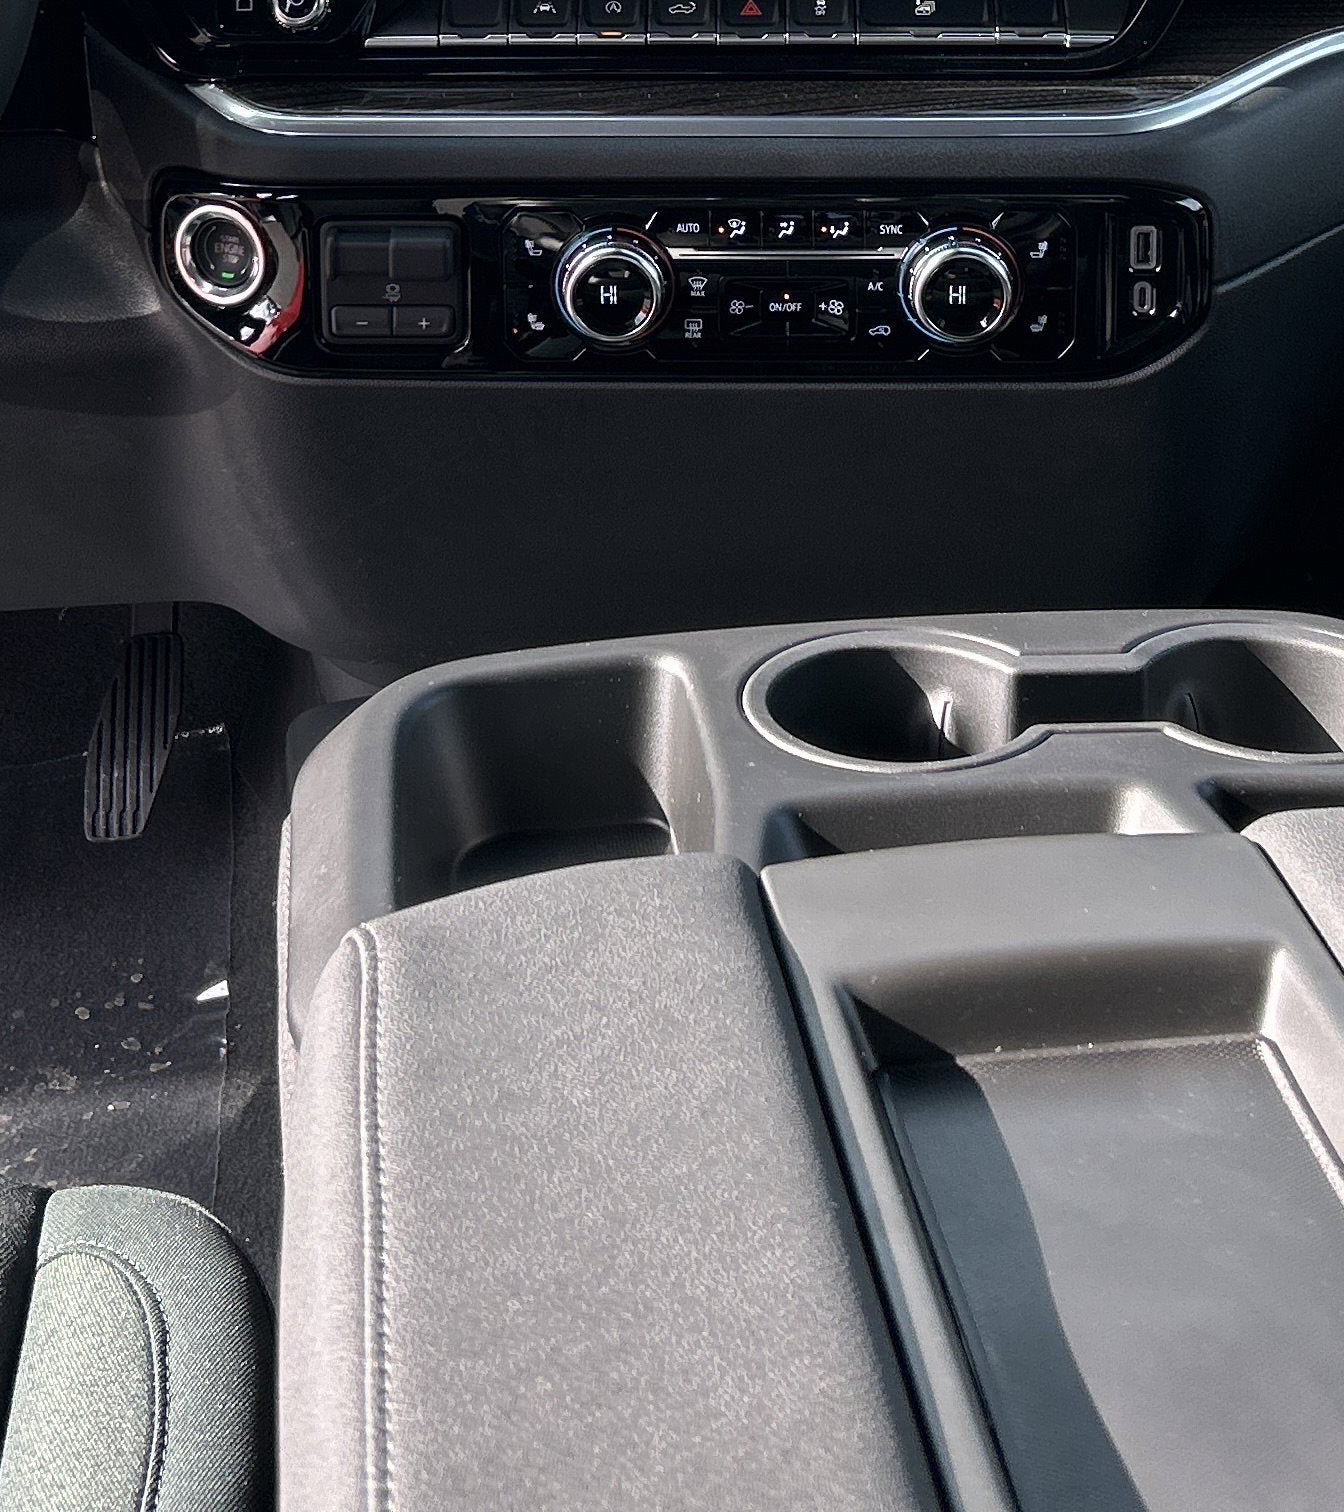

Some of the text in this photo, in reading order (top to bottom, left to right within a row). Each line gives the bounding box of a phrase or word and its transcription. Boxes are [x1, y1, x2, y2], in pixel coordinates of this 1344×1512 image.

[676, 223, 700, 234] AUTO
[879, 224, 903, 235] SYNC
[214, 242, 245, 257] ENGINE
[867, 282, 884, 292] A/C
[600, 285, 618, 305] HI
[948, 285, 967, 305] HI
[768, 303, 803, 312] ON/OFF
